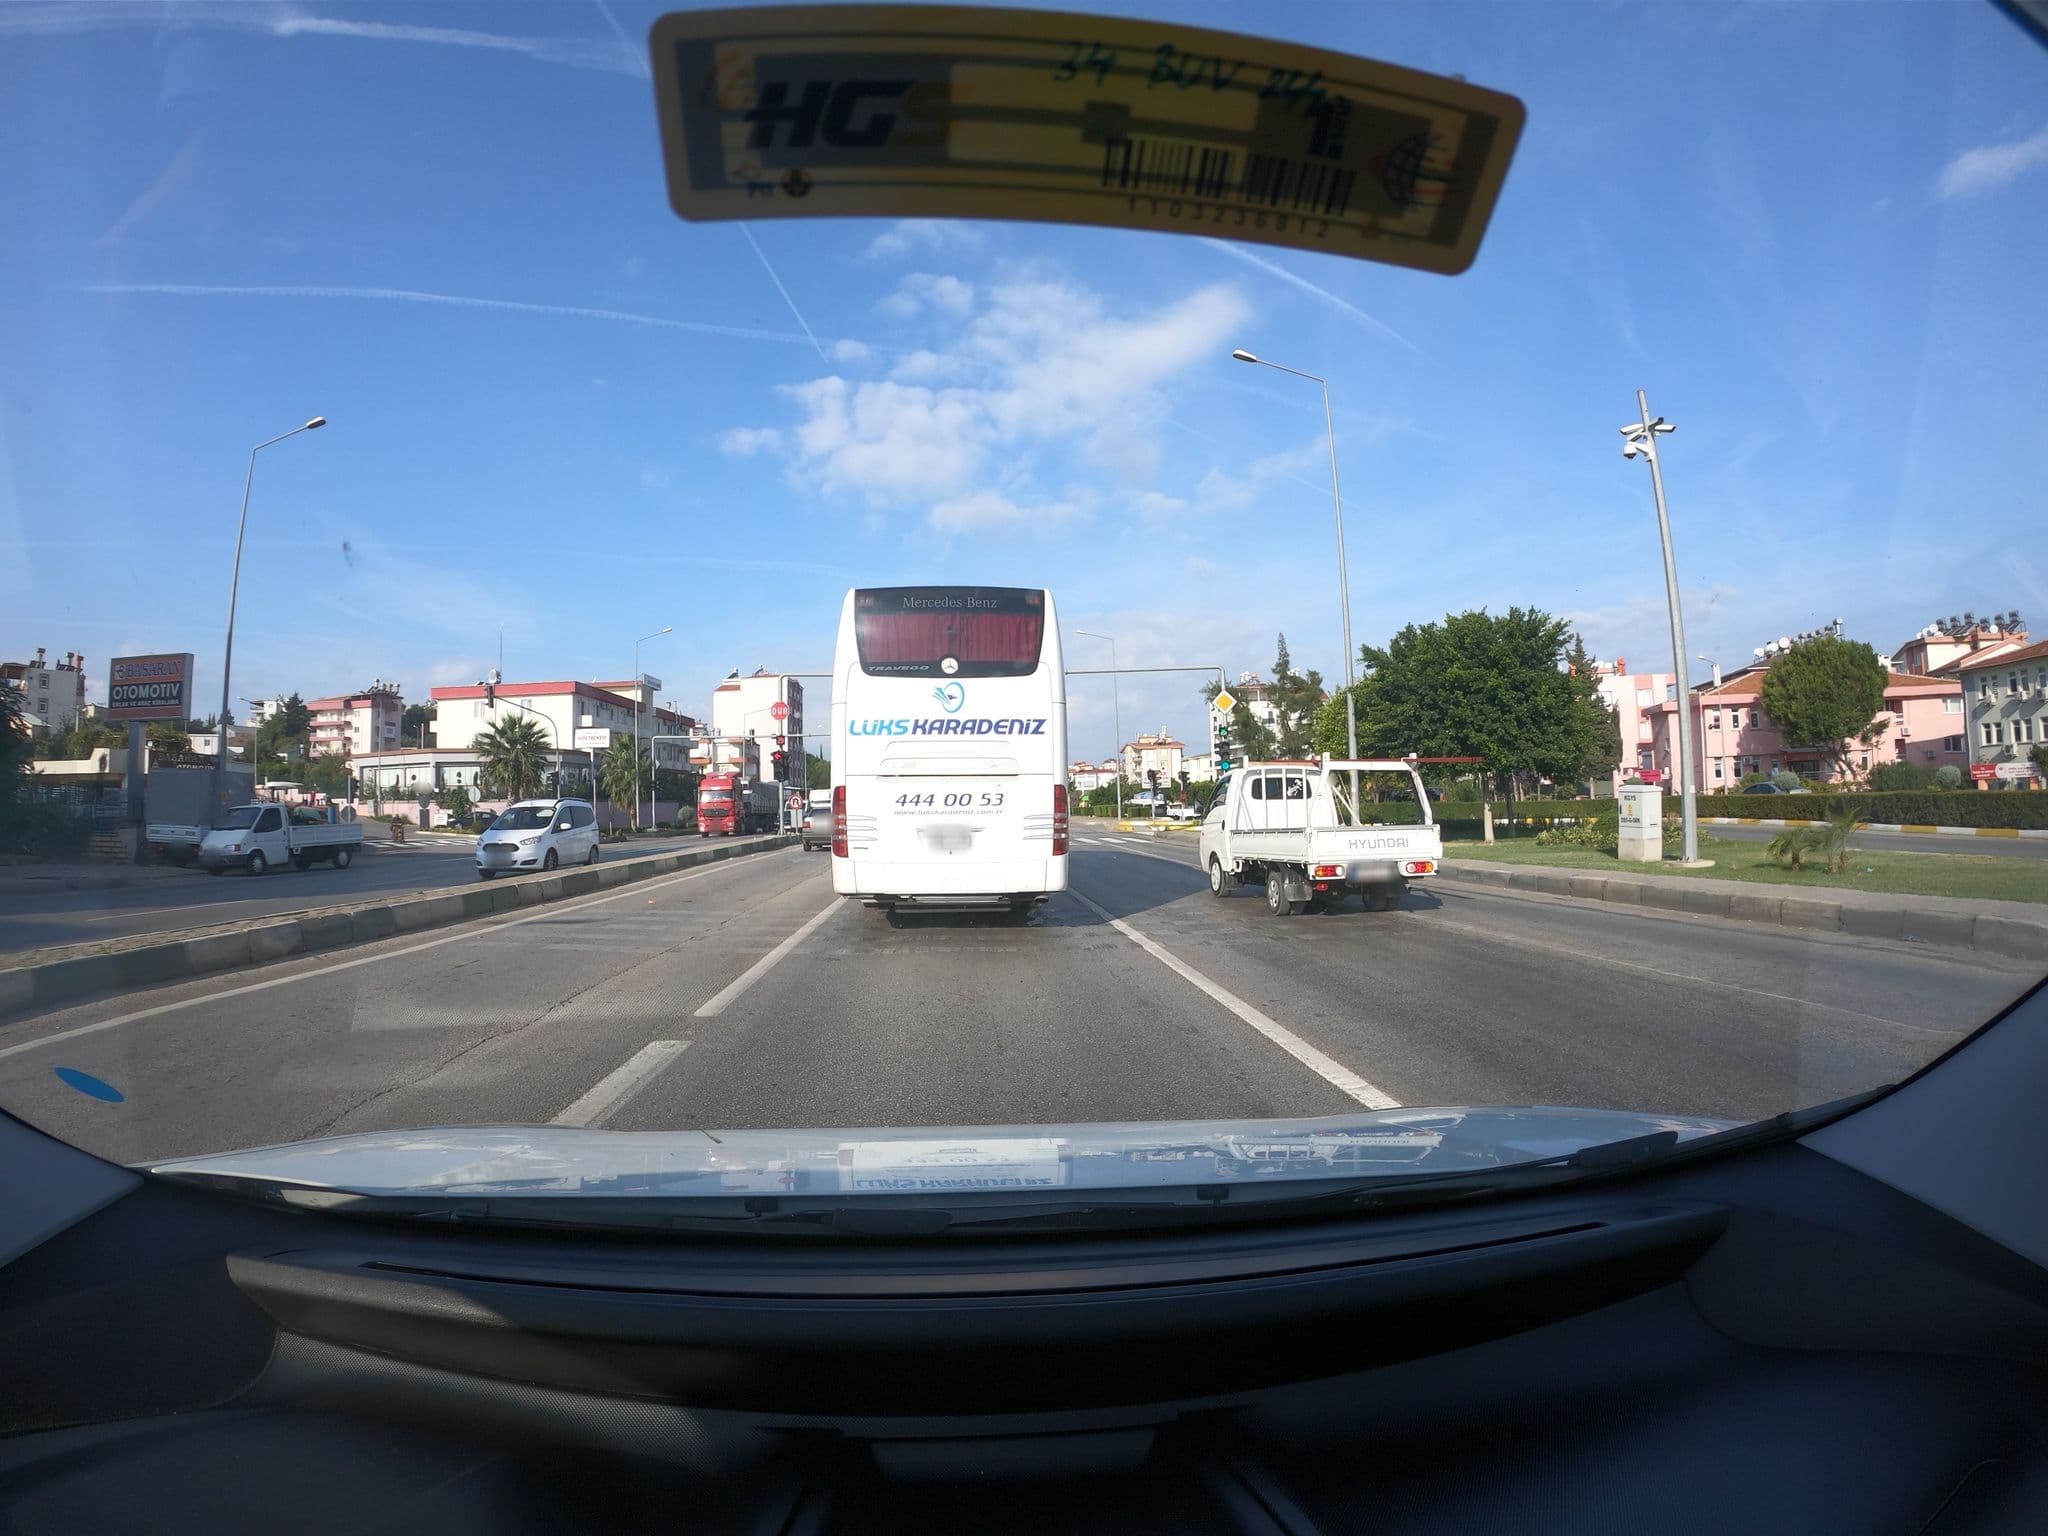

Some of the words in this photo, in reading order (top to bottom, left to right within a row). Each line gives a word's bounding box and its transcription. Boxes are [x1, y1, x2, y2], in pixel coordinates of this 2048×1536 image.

[1053, 41, 1118, 86] 34
[745, 79, 974, 148] HGS
[867, 664, 930, 672] TRAVEGO
[771, 707, 788, 715] DUR
[848, 718, 909, 736] LÜKS
[895, 793, 935, 807] 444
[944, 793, 973, 807] 00
[979, 793, 1004, 807] 53
[1348, 837, 1409, 849] HYUNDAI
